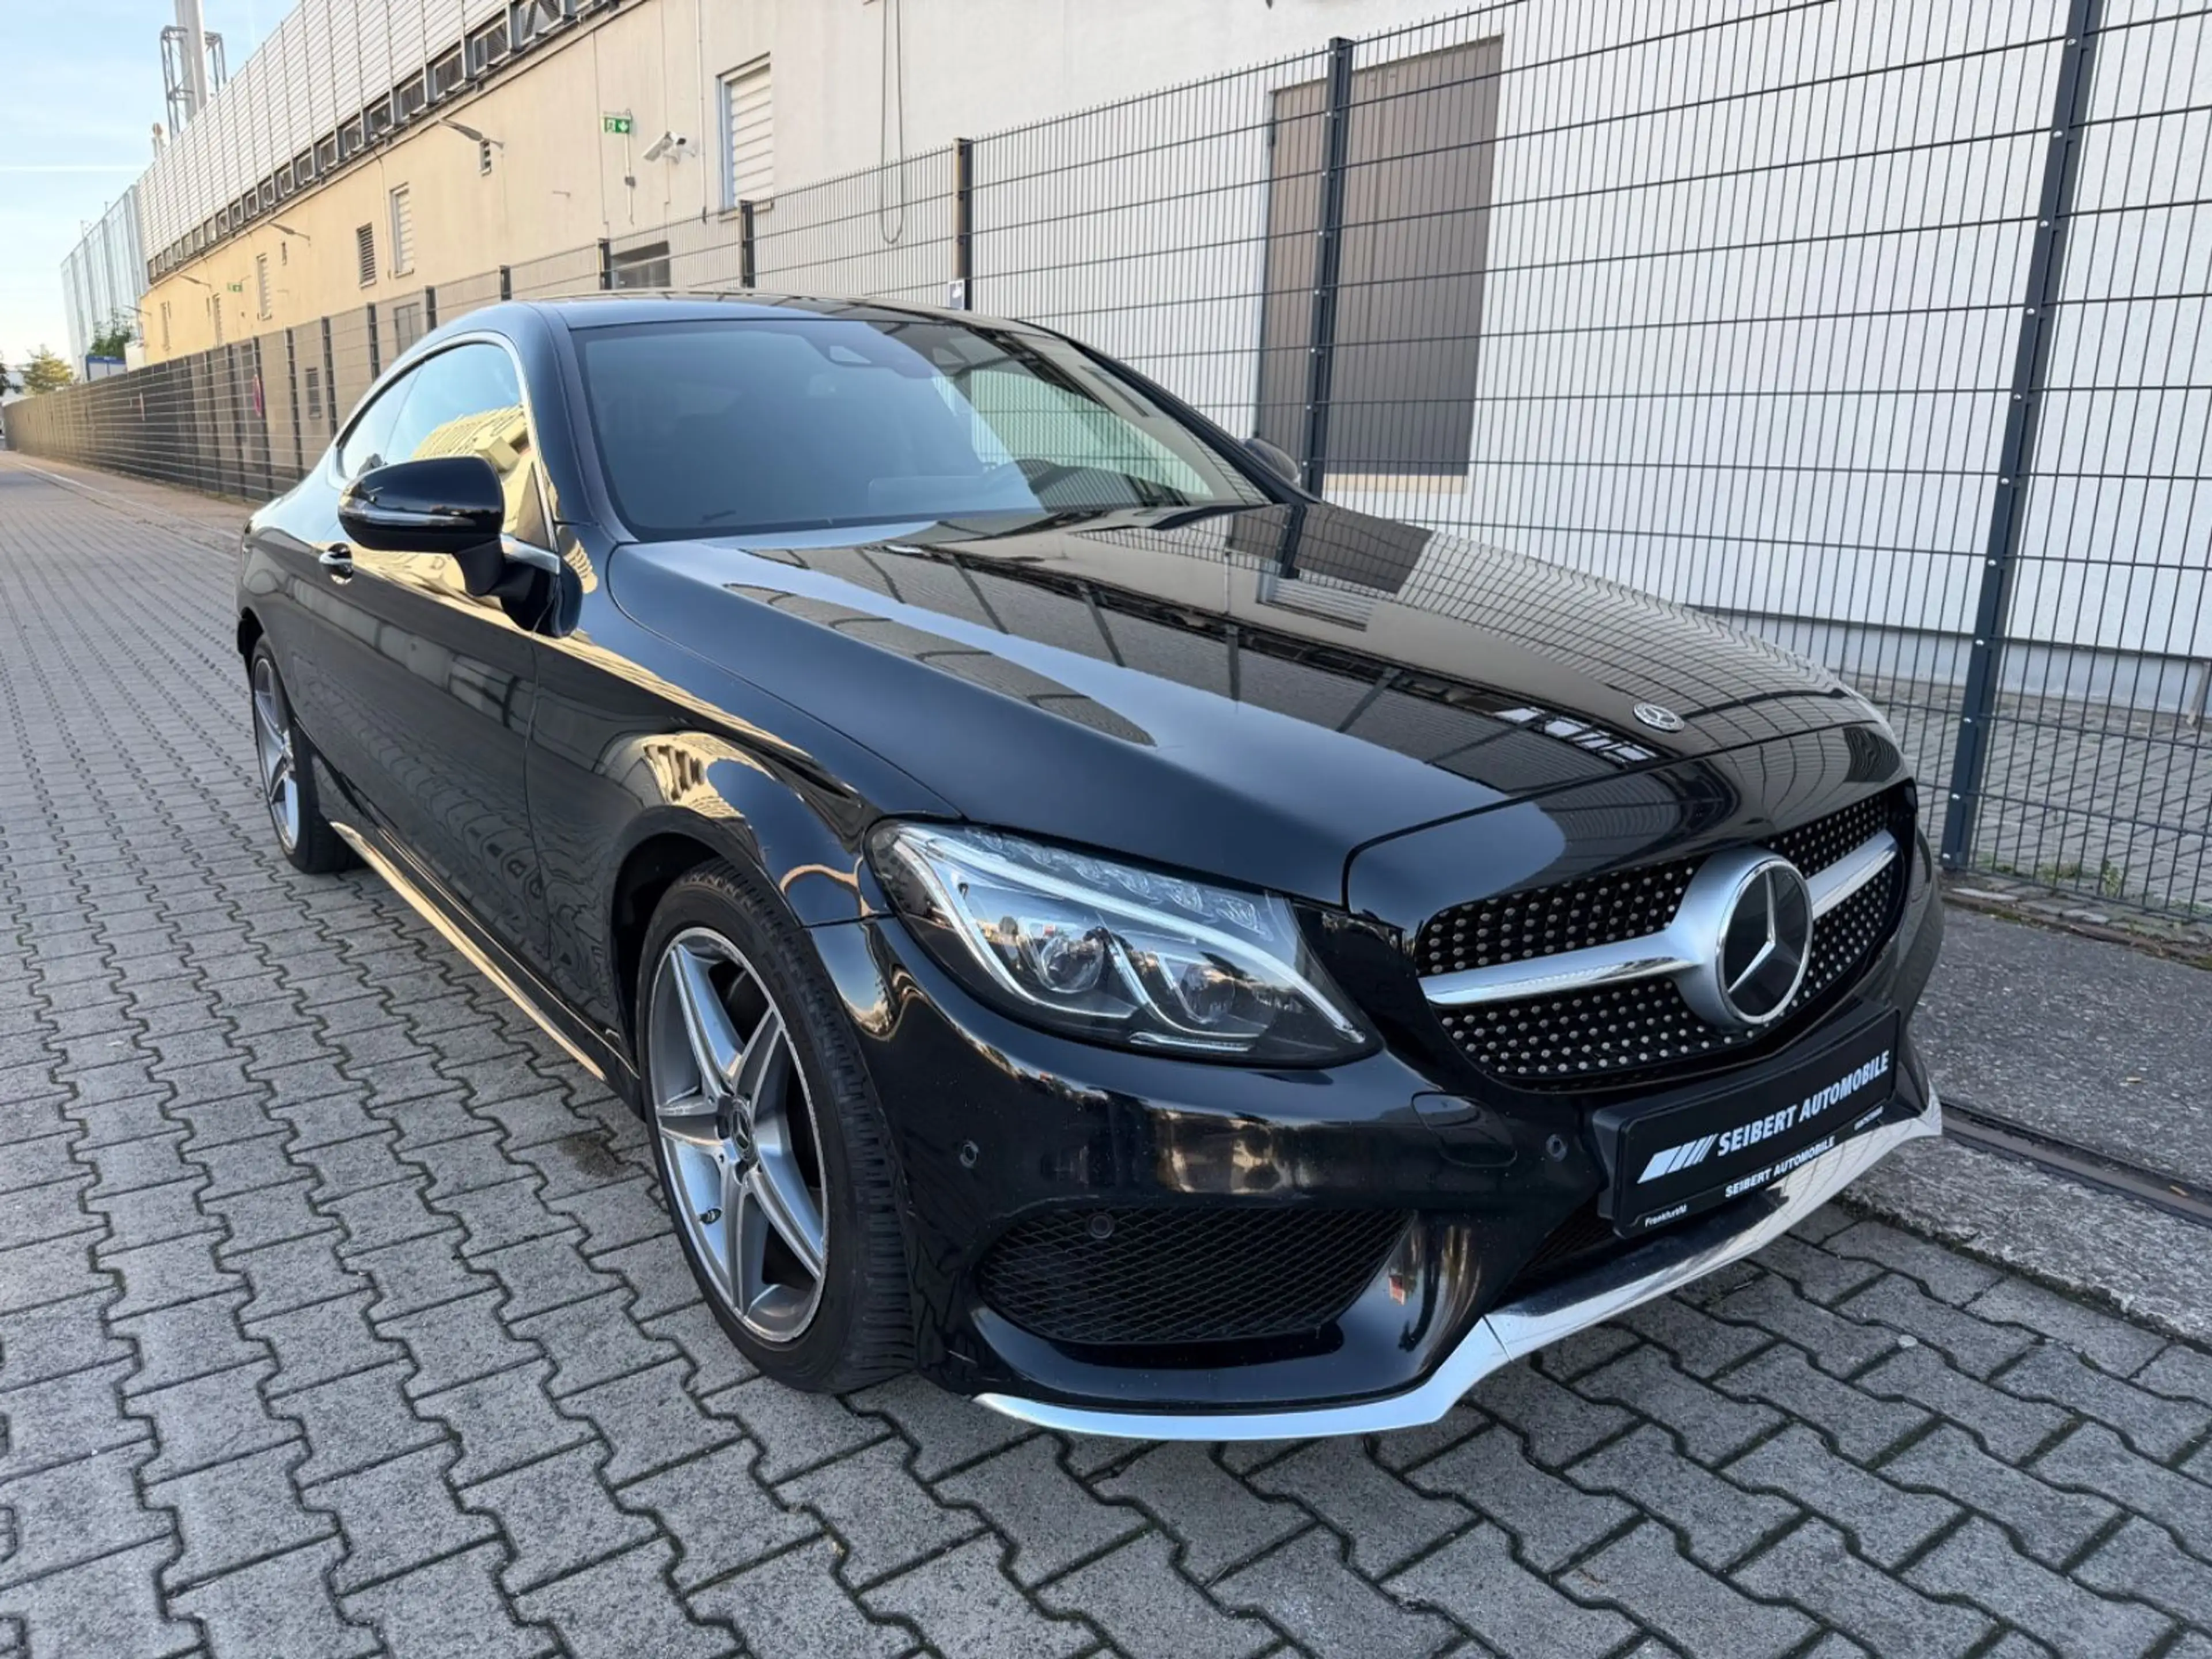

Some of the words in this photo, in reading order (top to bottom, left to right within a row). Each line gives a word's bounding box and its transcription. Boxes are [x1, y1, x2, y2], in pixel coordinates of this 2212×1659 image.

[1717, 1104, 1798, 1157] SEIBERT
[1798, 1050, 1889, 1123] AUTOMOBILE
[1725, 1168, 1772, 1198] SEIBERT
[1774, 1135, 1836, 1176] AUTOMOBILE
